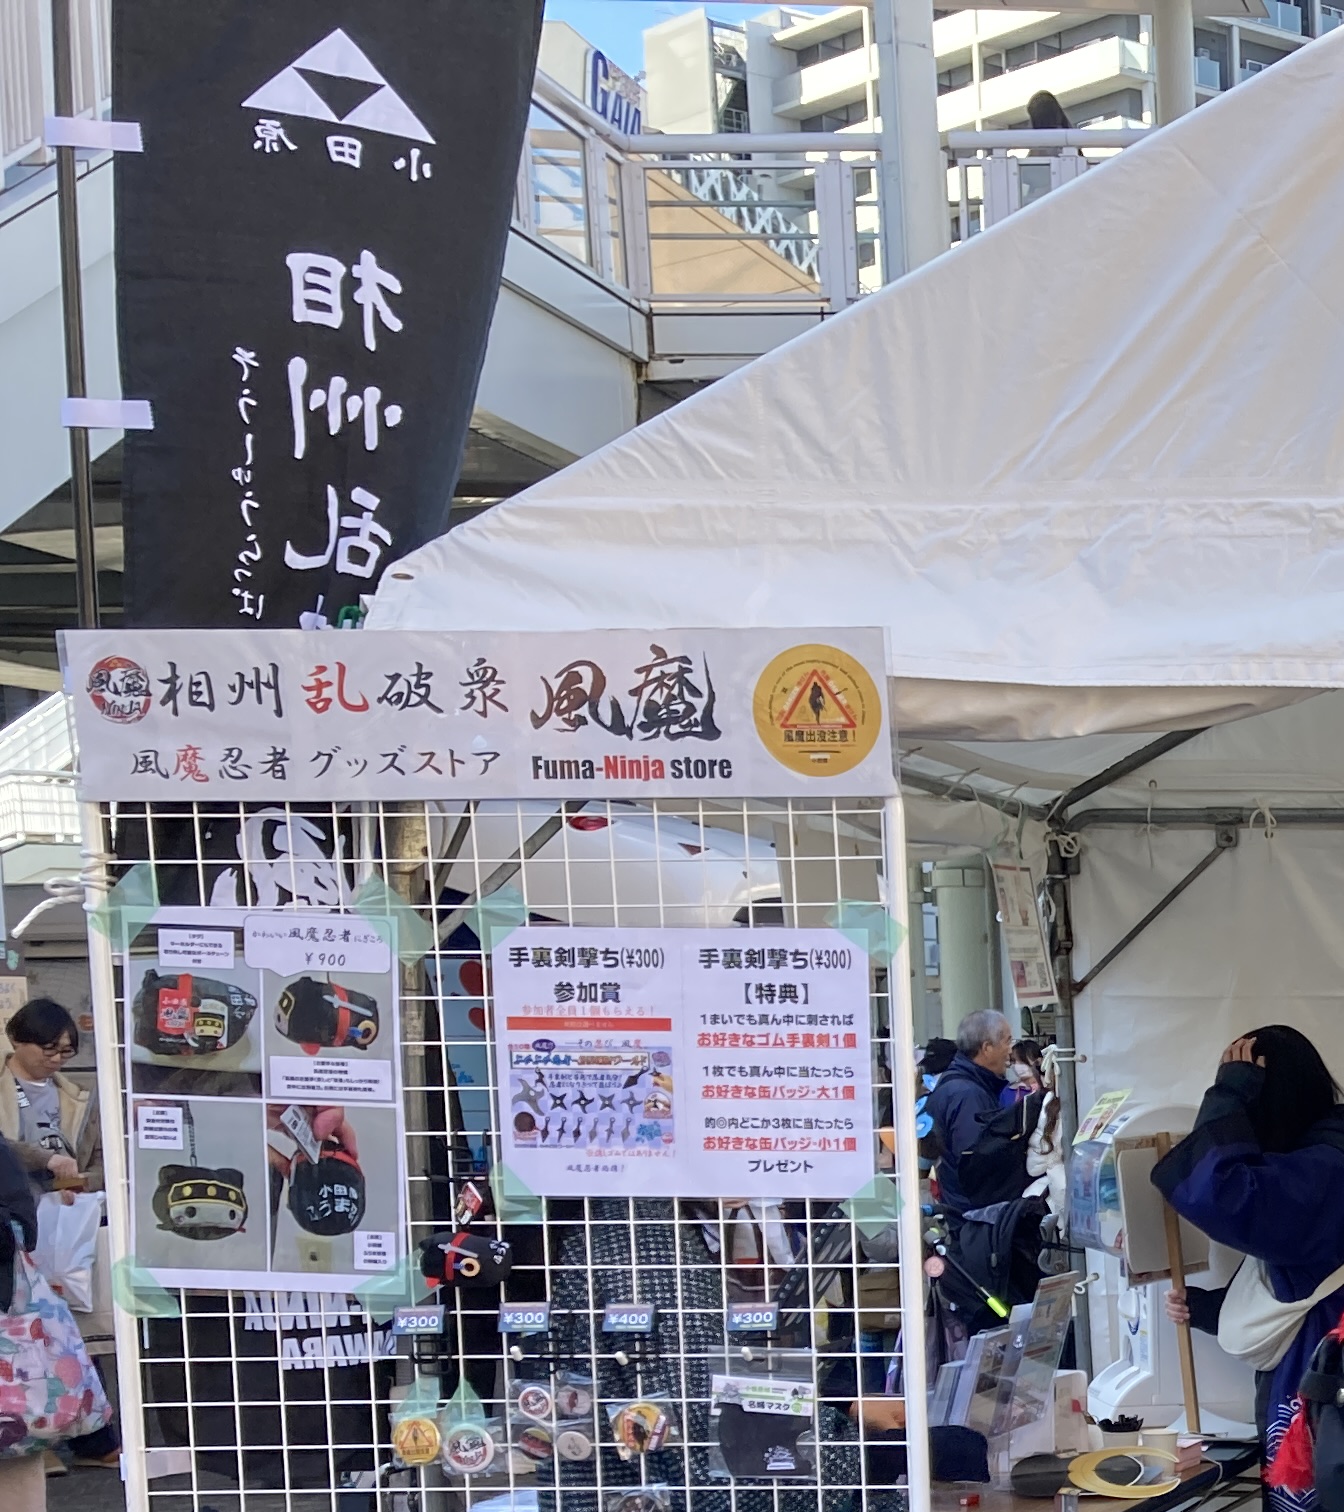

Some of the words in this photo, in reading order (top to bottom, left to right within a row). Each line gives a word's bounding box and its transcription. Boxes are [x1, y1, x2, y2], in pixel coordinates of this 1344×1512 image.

[591, 50, 642, 134] GAIA
[130, 744, 290, 783] 風魔忍者
[310, 743, 501, 780] グッズストア
[532, 755, 665, 782] Fuma-Ninja
[671, 756, 733, 780] store
[305, 952, 346, 966] ¥900
[509, 946, 665, 969] 手裏剣撃ち(¥300)
[698, 948, 852, 970] 手裏剣撃ち(¥300)
[553, 981, 621, 1003] 参加賞
[744, 983, 809, 1005] 【特典】
[748, 1160, 814, 1173] プレゼント
[398, 1315, 439, 1328] ¥300
[504, 1311, 545, 1324] ¥300
[608, 1313, 649, 1325] ¥400
[732, 1311, 774, 1324] ¥300
